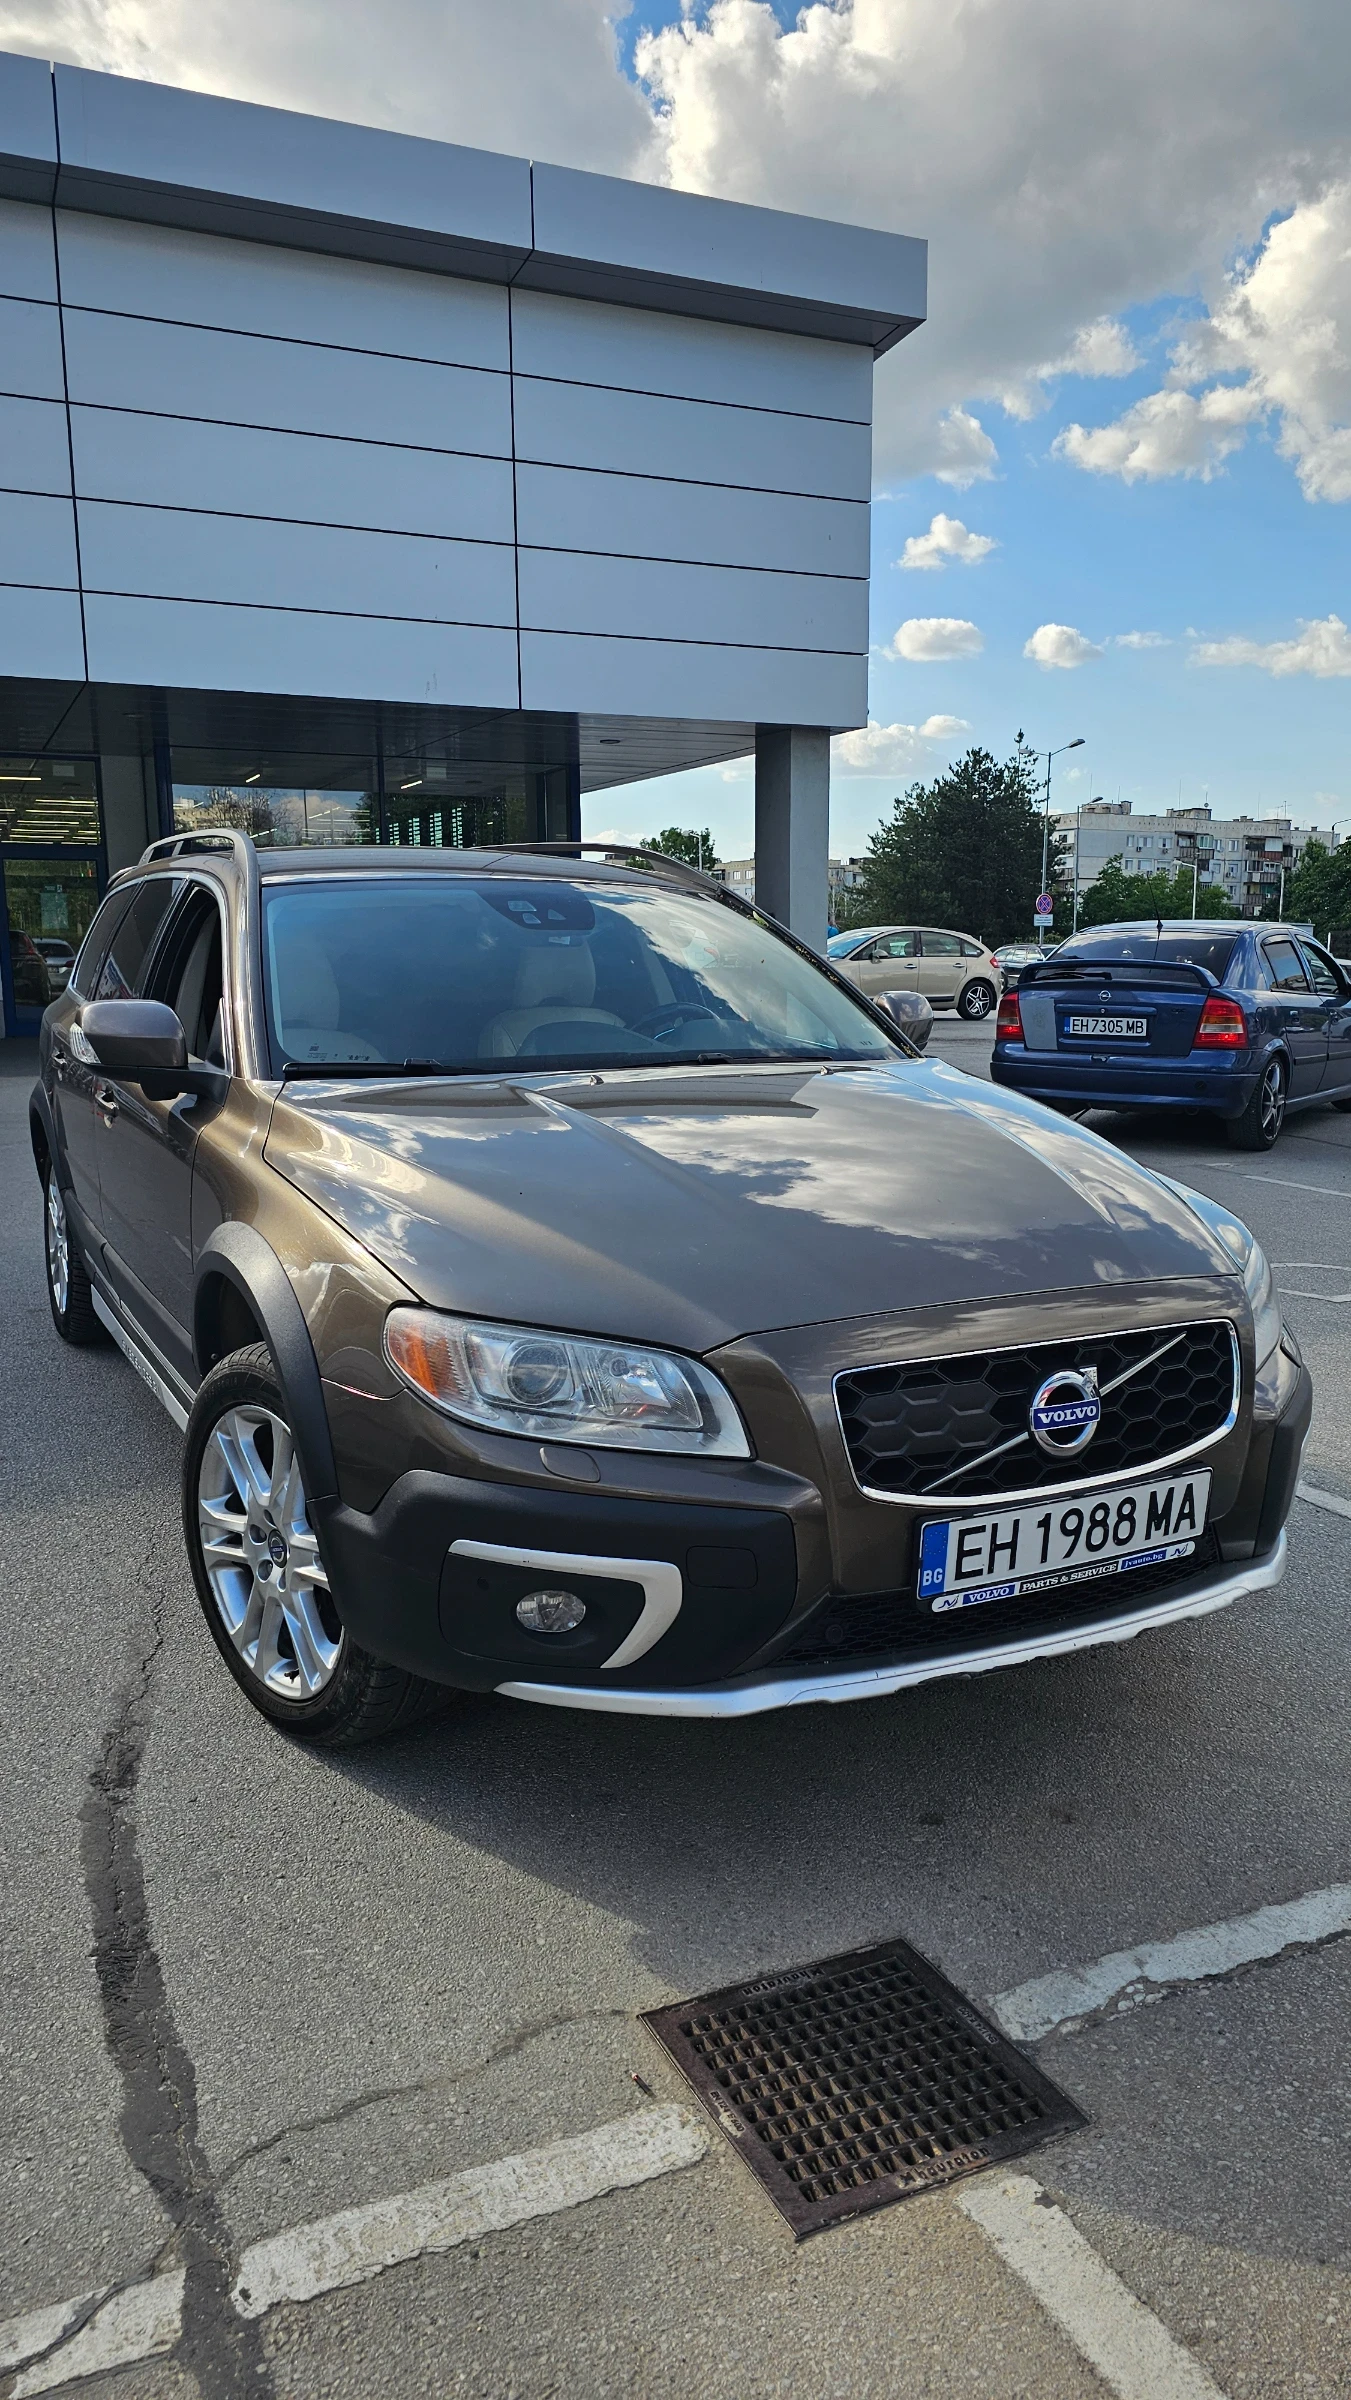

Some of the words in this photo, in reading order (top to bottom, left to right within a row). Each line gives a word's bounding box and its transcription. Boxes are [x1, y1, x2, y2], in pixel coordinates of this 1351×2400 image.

[1072, 1019, 1089, 1032] EH
[1091, 1019, 1123, 1033] 7305
[1126, 1020, 1144, 1034] MB
[1038, 1405, 1097, 1424] VOLVO
[954, 1518, 1020, 1581] EH
[1036, 1496, 1137, 1564] 1988
[1144, 1482, 1196, 1541] MA
[922, 1567, 943, 1587] BG
[968, 1587, 1010, 1602] VOLVO
[1021, 1576, 1059, 1592] PARTS
[1060, 1575, 1069, 1583] &
[1070, 1563, 1117, 1581] SERVICE
[1123, 1552, 1164, 1568] jvauto.bg
[913, 2147, 990, 2180] hauraton
